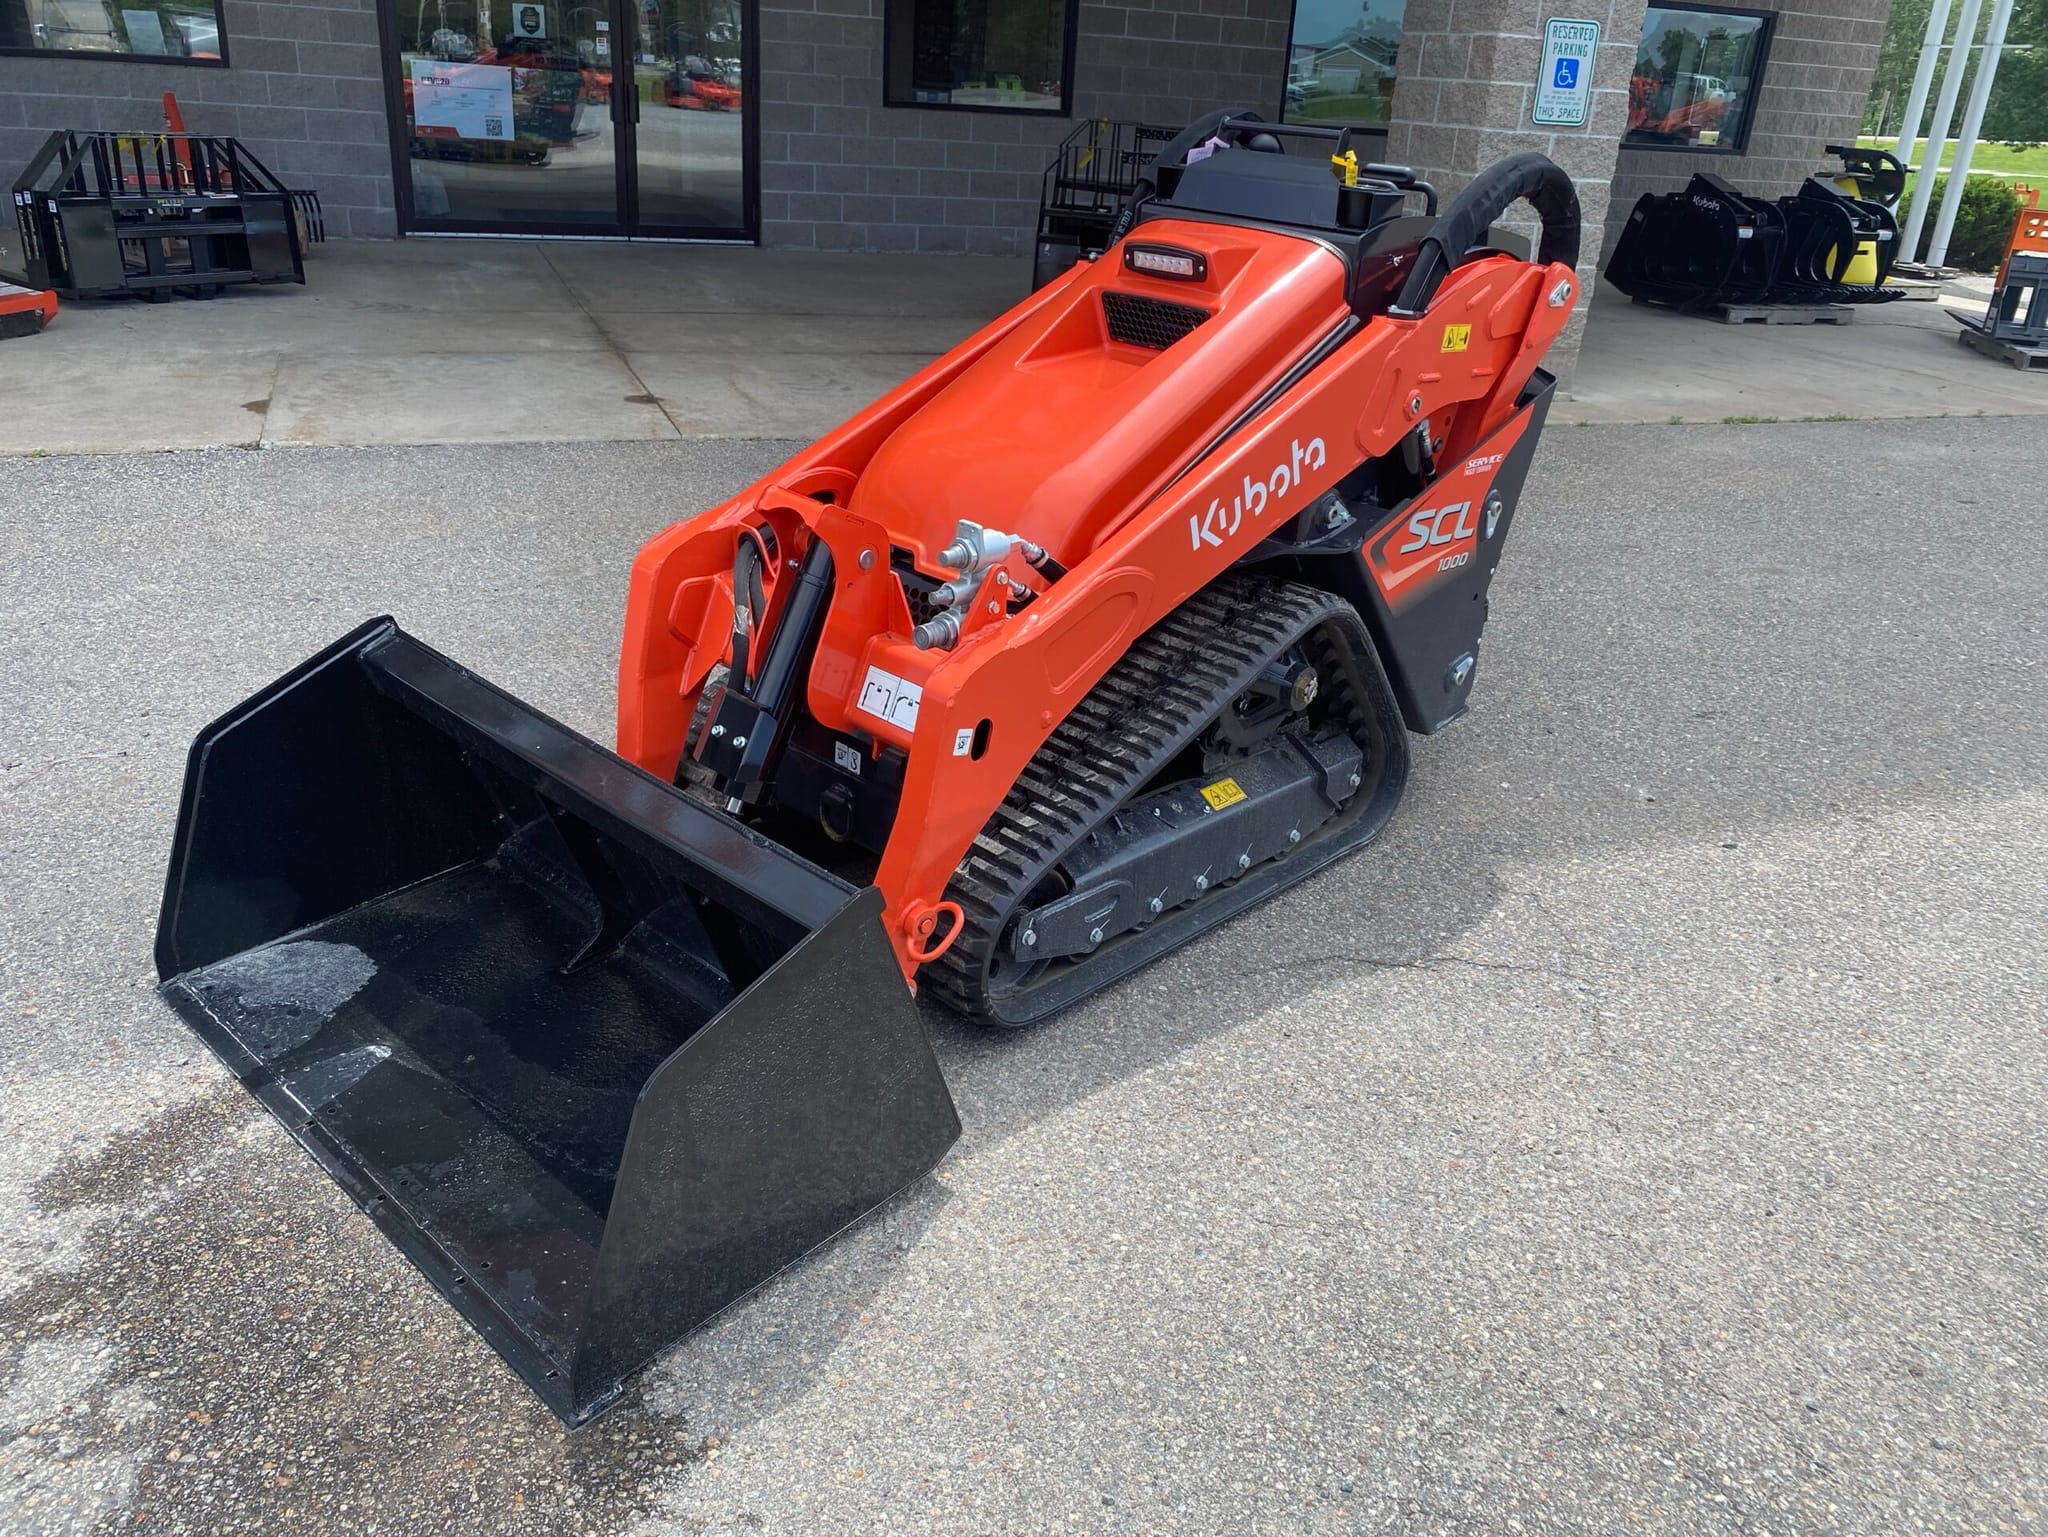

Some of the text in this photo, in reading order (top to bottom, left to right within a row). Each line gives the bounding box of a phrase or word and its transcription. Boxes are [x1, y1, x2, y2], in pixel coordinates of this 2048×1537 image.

[1552, 25, 1594, 41] RESERVED
[1553, 42, 1588, 57] PARKING
[1538, 106, 1581, 119] THIS SPACE
[1693, 195, 1720, 210] Kubota
[1190, 437, 1326, 551] Kubota
[1400, 501, 1474, 554] SCL
[1437, 552, 1469, 572] 1000
